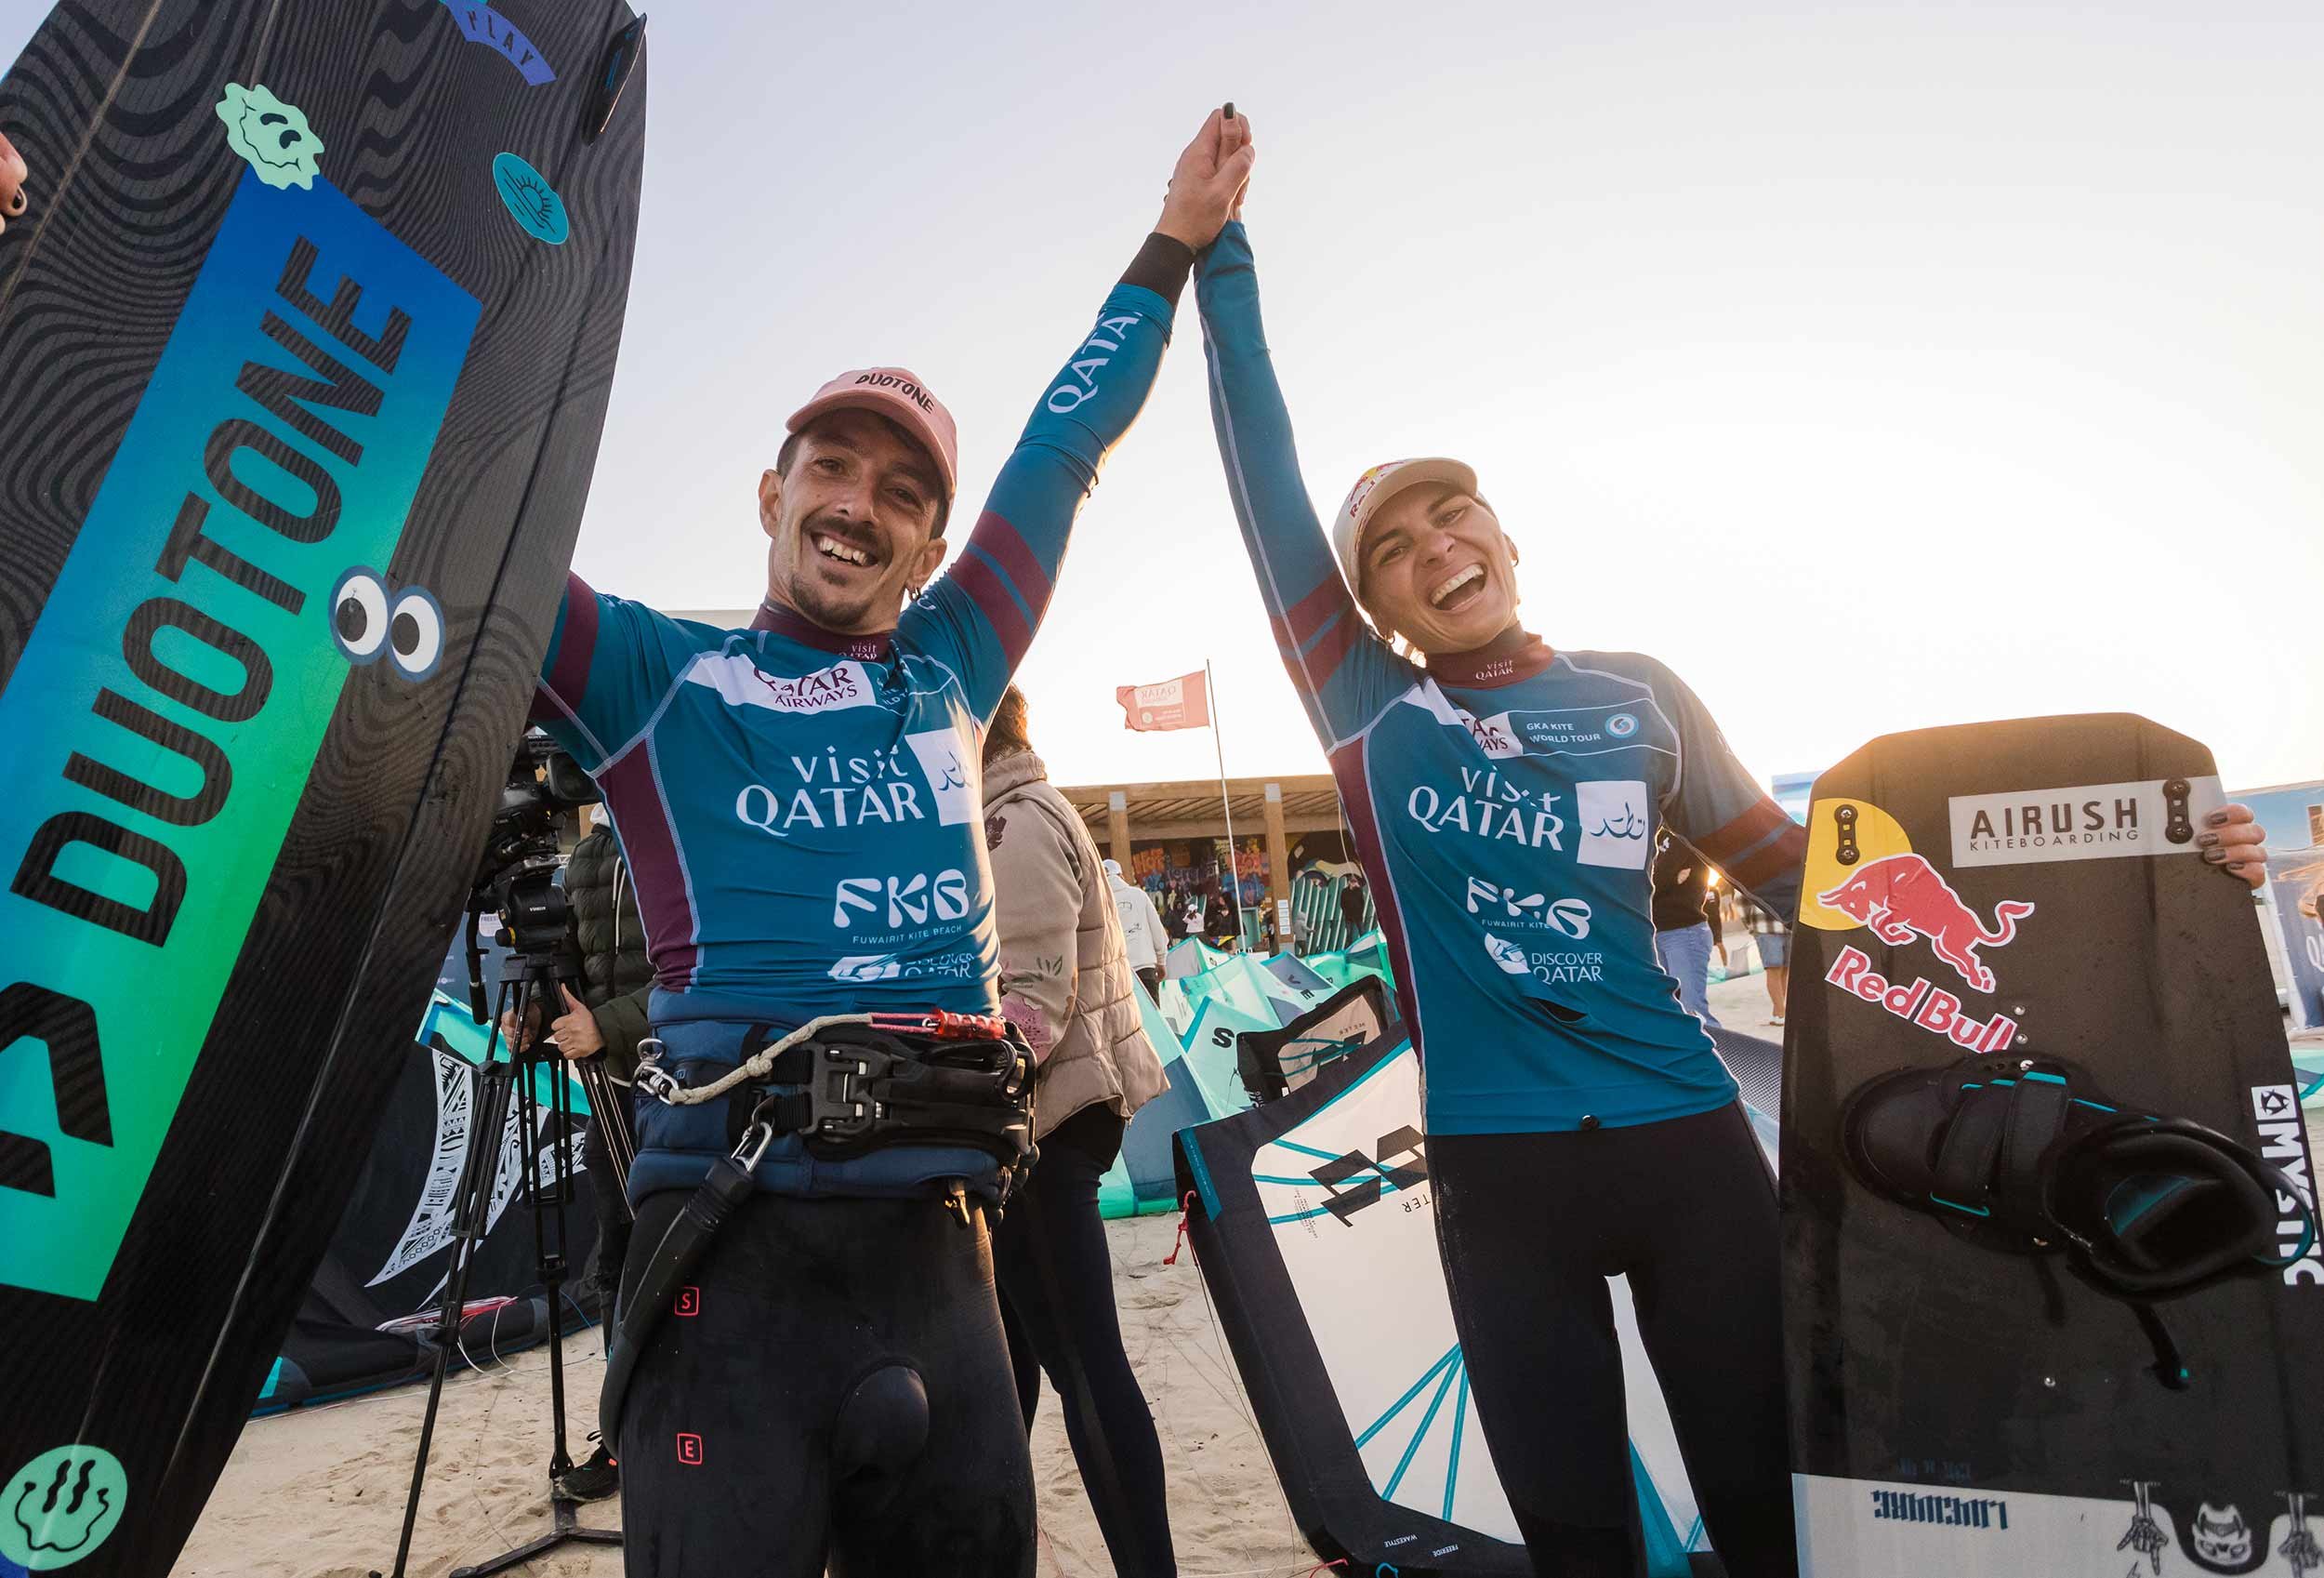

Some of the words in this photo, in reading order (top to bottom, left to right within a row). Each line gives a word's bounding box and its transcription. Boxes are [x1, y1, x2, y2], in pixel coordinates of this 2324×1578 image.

[1048, 310, 1143, 414] QATA
[854, 372, 935, 415] DUOTONE
[9, 234, 413, 948] DUOTONE
[1475, 667, 1513, 681] QATAR
[774, 684, 858, 708] AIRWAYS
[1525, 723, 1550, 731] GKA
[1550, 723, 1575, 731] KITE
[1529, 734, 1568, 743] WORLD
[1569, 733, 1602, 743] TOUR
[735, 782, 926, 838] QATAR
[1407, 785, 1564, 853] QATAR
[1970, 797, 2139, 841] AIRUSH
[1969, 829, 2140, 853] KITEBOARDING
[852, 934, 905, 945] FUWAIRIT
[908, 930, 930, 940] KITE
[932, 924, 963, 936] BEACH
[1481, 919, 1525, 929] FUWAIRIT
[1531, 952, 1604, 965] DISCOVER
[1533, 965, 1604, 986] QATAR
[1826, 945, 1931, 1021] Red
[1917, 982, 2020, 1054] Bull
[1383, 1533, 1419, 1548] WAKESTYLE
[1432, 1544, 1459, 1558] FREERIDE
